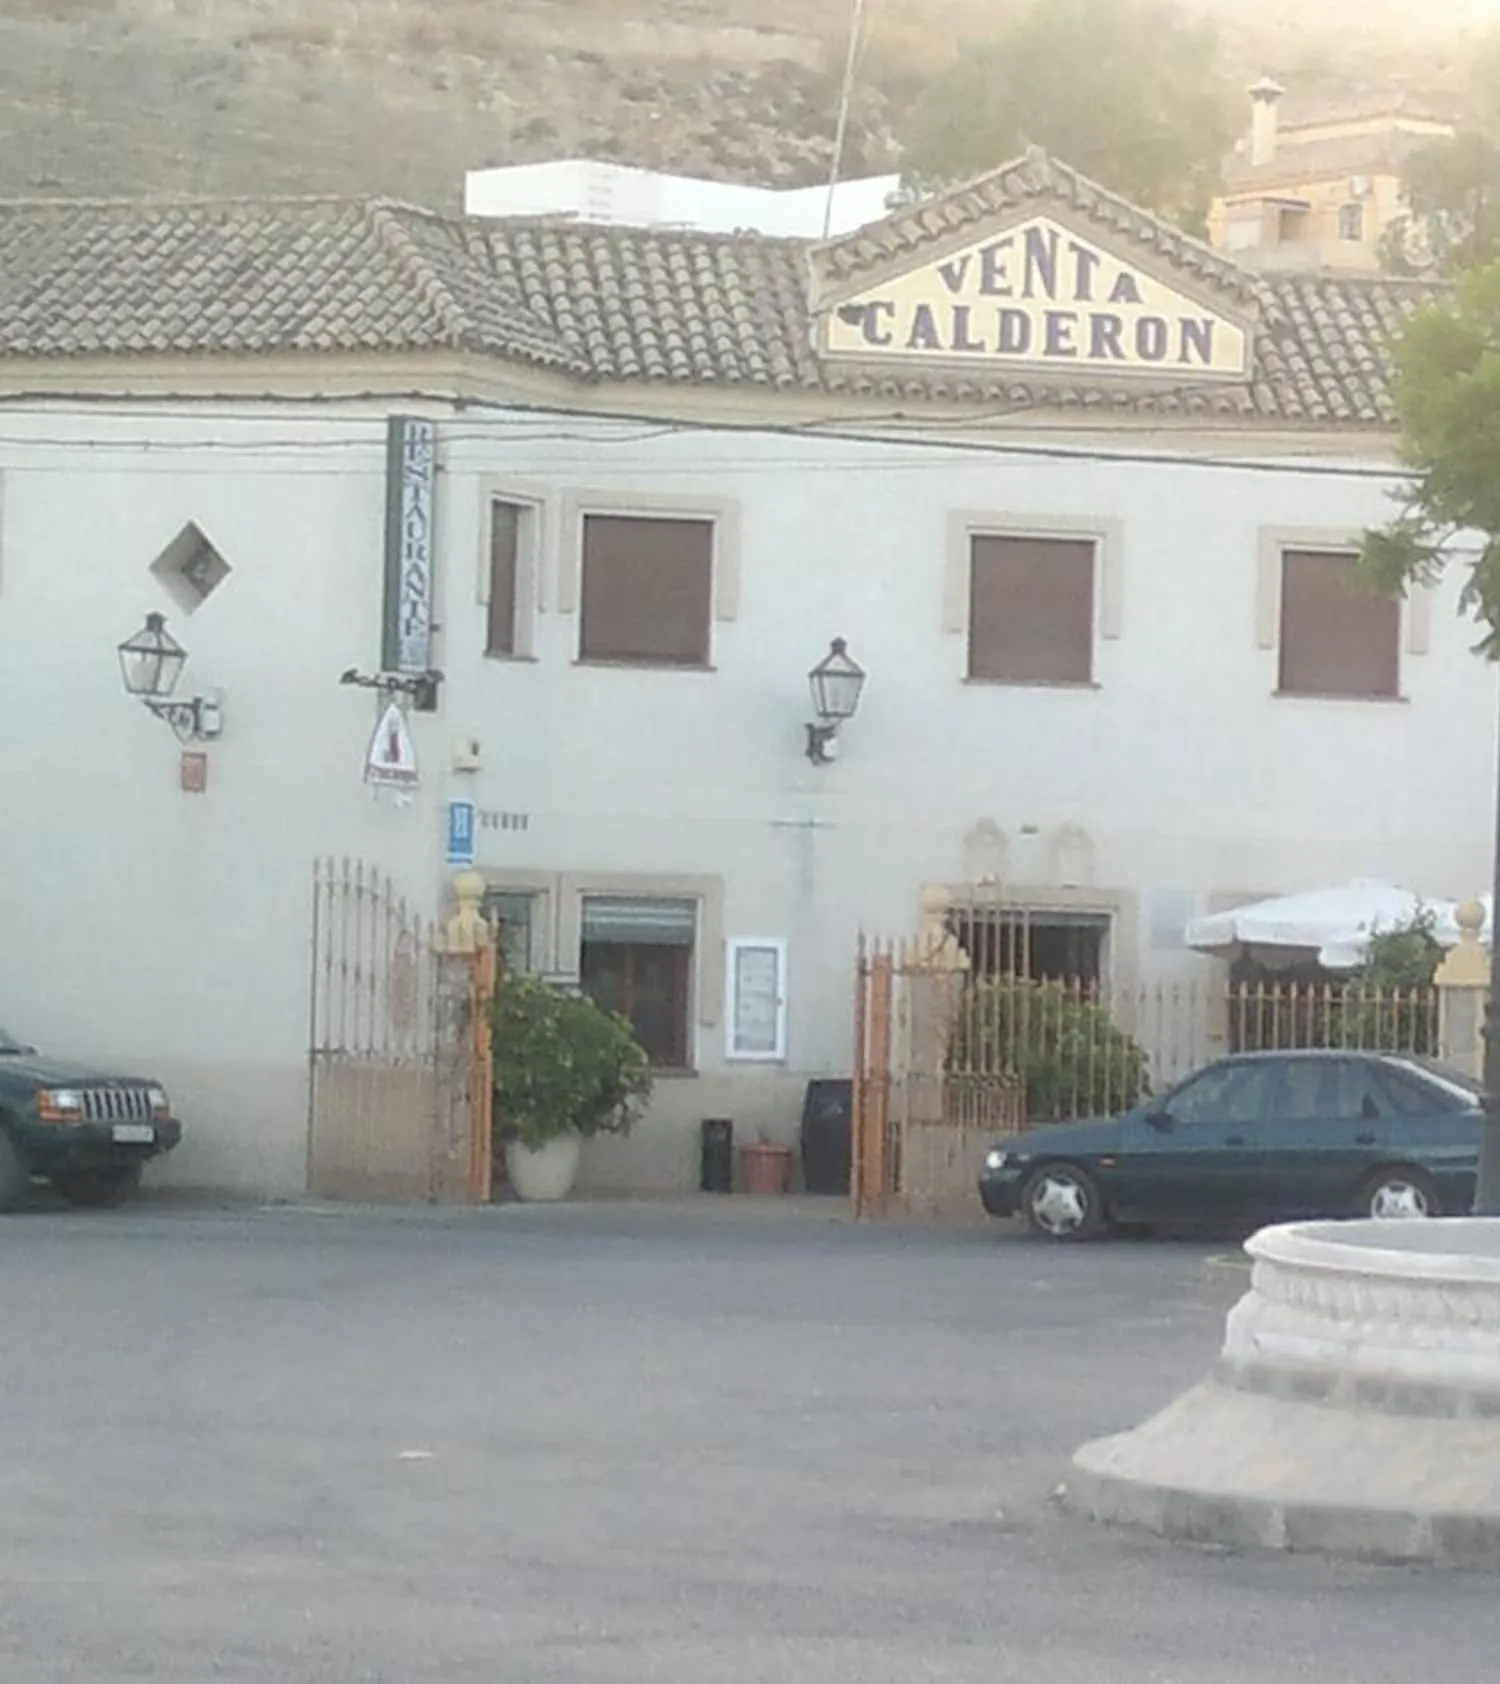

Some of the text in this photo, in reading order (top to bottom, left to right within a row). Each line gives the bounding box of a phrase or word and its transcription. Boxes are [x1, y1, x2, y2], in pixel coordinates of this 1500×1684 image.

[939, 227, 1143, 304] VENTA
[861, 302, 1215, 365] CALDERON
[403, 424, 429, 637] RESTAURANTE
